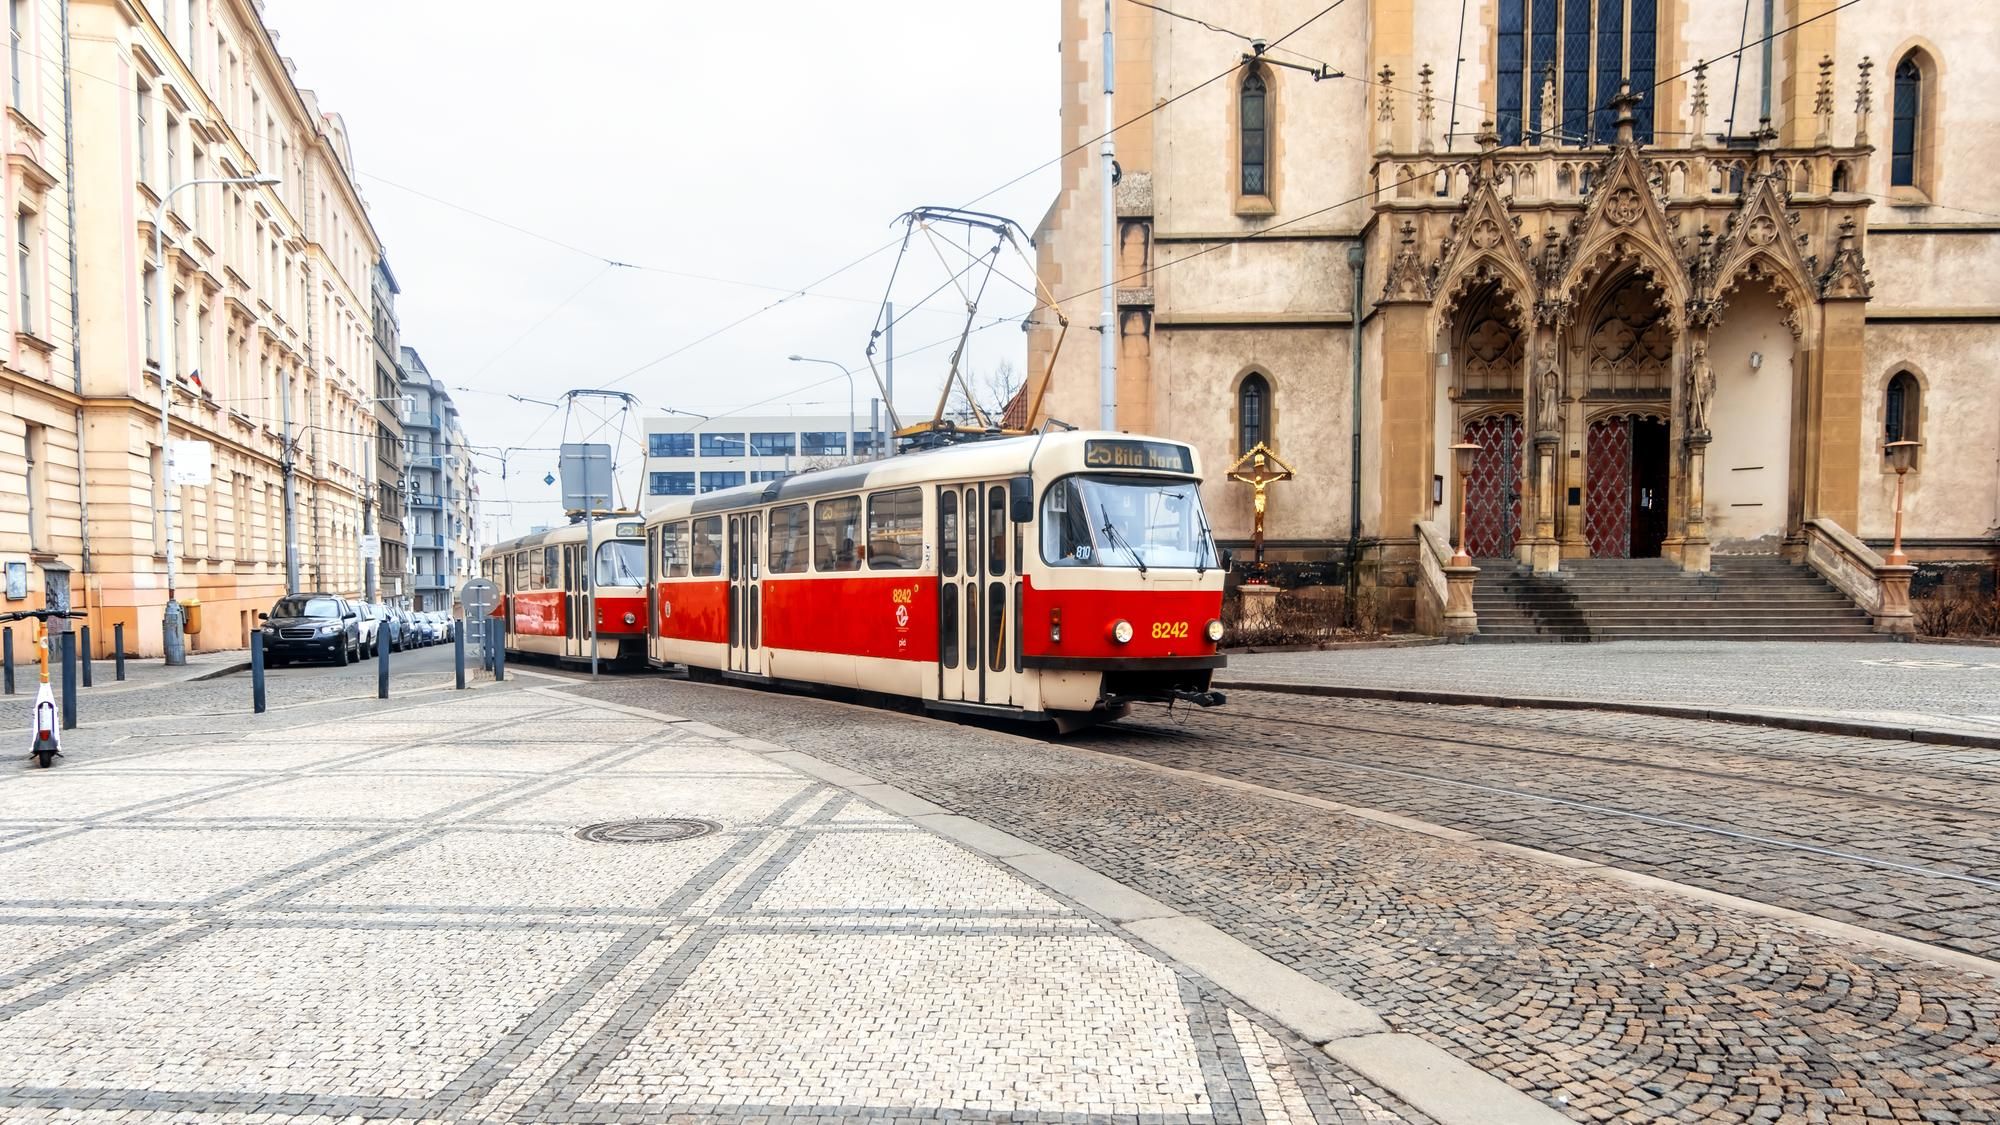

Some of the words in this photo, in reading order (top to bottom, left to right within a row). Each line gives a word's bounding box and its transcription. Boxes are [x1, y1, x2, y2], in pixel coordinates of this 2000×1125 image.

[1076, 545, 1091, 560] 810
[893, 588, 912, 603] 8242
[1151, 621, 1189, 638] 8242
